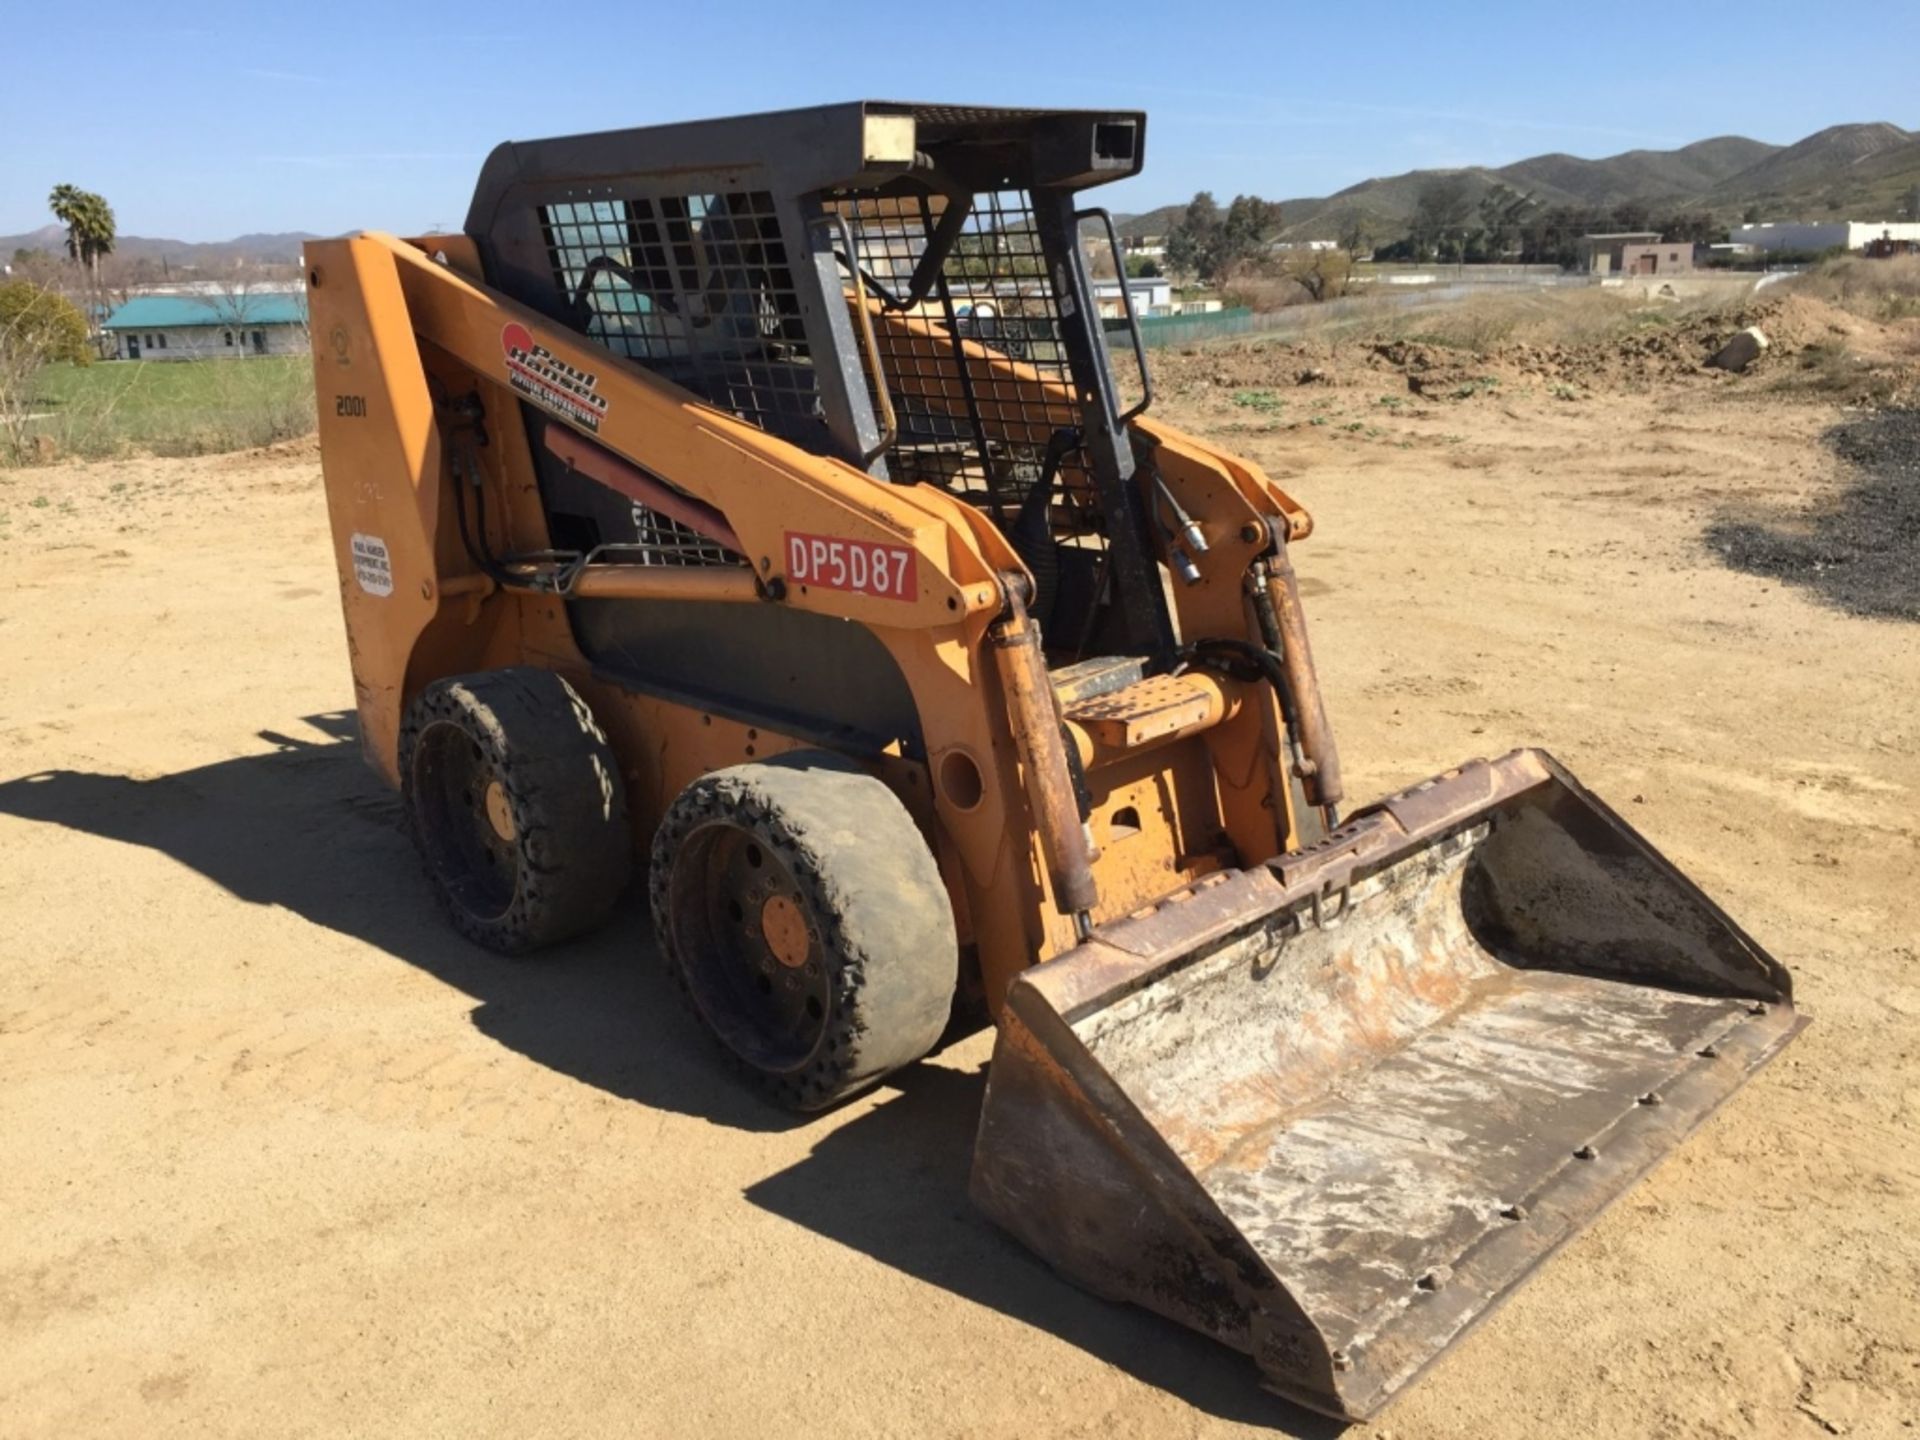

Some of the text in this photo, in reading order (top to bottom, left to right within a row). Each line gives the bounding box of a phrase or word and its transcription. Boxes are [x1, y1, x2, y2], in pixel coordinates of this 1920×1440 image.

[510, 346, 607, 409] Hansen
[531, 344, 596, 387] Paul
[335, 395, 367, 418] 2001
[790, 537, 909, 595] DP5D87
